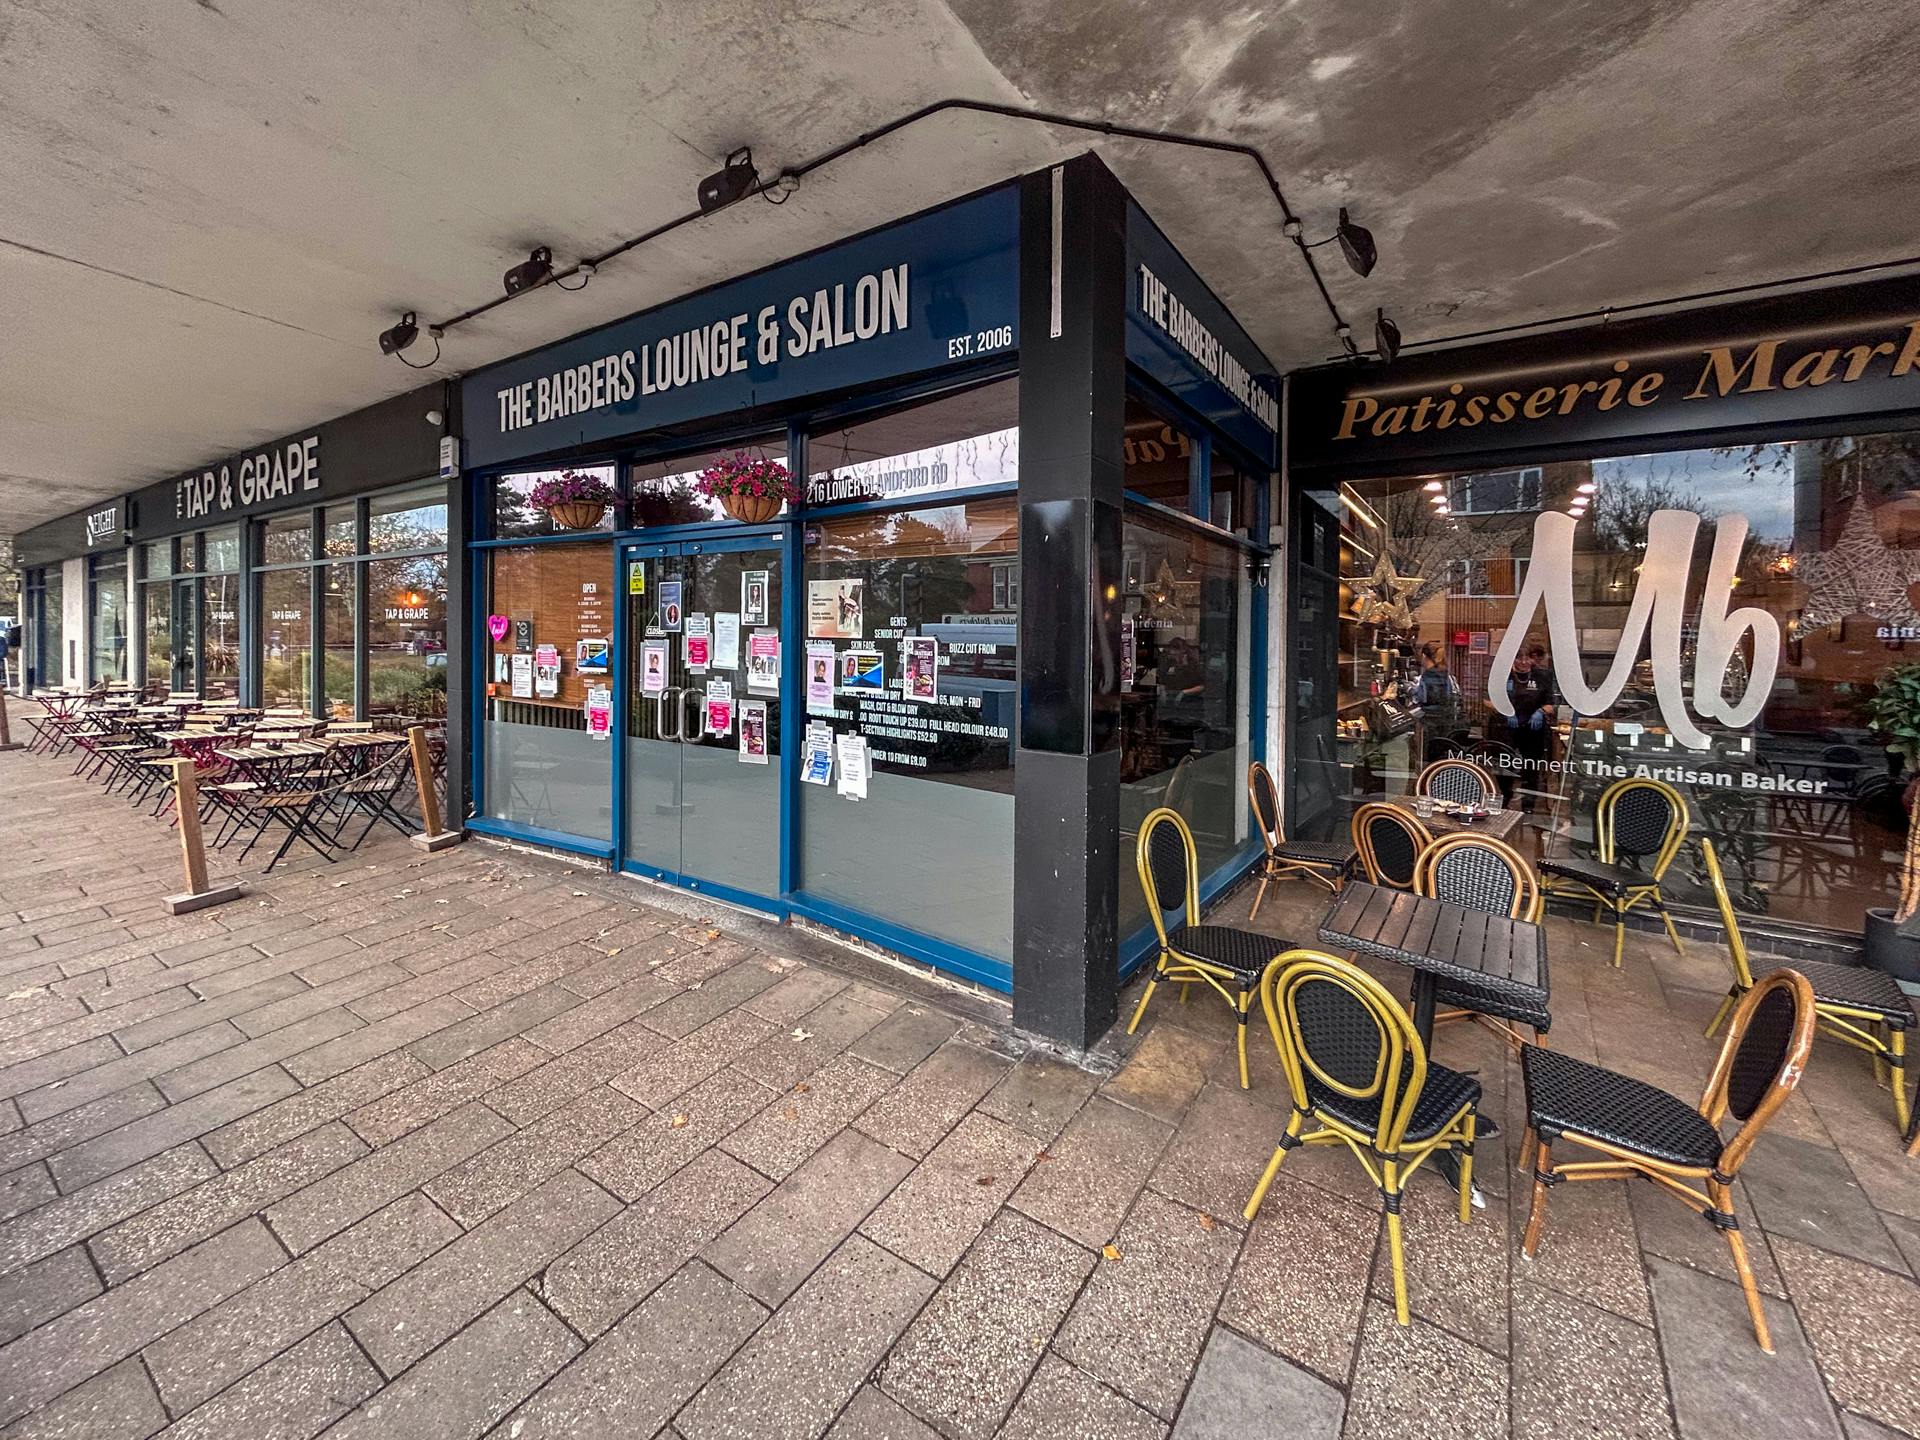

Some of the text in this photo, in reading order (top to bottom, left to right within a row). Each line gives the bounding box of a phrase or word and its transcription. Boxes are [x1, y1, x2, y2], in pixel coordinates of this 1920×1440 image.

[498, 264, 909, 433] THE BARBERS LOUNGE & SALON
[948, 326, 1012, 359] EST. 2006
[1141, 263, 1278, 433] THE BARBERS LOUNGE & SALON
[1331, 319, 1920, 441] Patisserie Mark
[184, 435, 319, 518] TAP & GRAPE
[807, 463, 948, 504] 216 LOWER BLANDFORD RD
[582, 583, 597, 593] OPEN
[385, 608, 429, 619] TAP & GRAPE
[890, 617, 907, 627] GENTS
[874, 629, 903, 639] SENIOR CUT
[851, 641, 876, 650] SKIN FADE
[949, 643, 997, 654] BUZZ CUT FROM
[937, 656, 950, 666] ROM
[889, 678, 903, 688] LADIE
[890, 691, 901, 700] DRY
[949, 695, 963, 706] MON
[860, 700, 875, 711] WASH,
[876, 701, 886, 711] CUT
[891, 703, 906, 714] BLOW
[907, 704, 918, 715] DRY
[868, 712, 882, 723] ROOT
[882, 713, 899, 725] TOUCH
[900, 714, 907, 725] UP
[907, 717, 927, 729] £39.00
[929, 719, 943, 731] FULL
[944, 721, 960, 733] HEAD
[960, 723, 984, 736] COLOUR
[860, 724, 938, 743] T-SECTION HIGHLIGHTS £52.50
[887, 751, 894, 762] 10
[894, 752, 910, 765] FROM
[1448, 749, 1577, 774] Mark Bennett
[1582, 760, 1828, 794] The Artisan Baker
